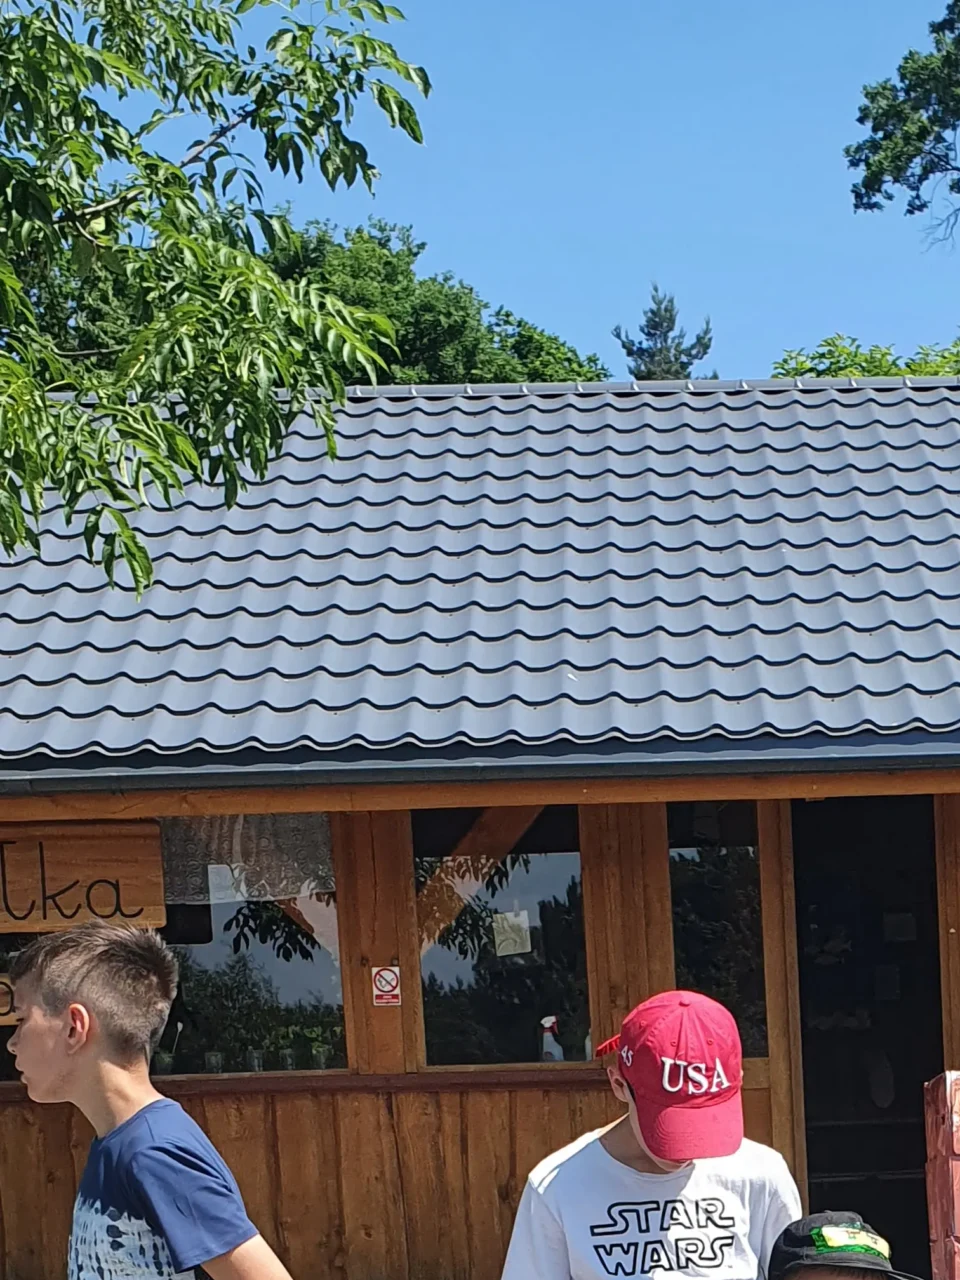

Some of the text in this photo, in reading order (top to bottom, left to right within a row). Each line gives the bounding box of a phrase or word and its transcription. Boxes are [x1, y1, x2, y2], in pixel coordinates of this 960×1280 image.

[621, 1045, 634, 1067] 45
[661, 1056, 731, 1095] USA
[590, 1198, 735, 1236] STAR
[593, 1236, 735, 1276] WARS
